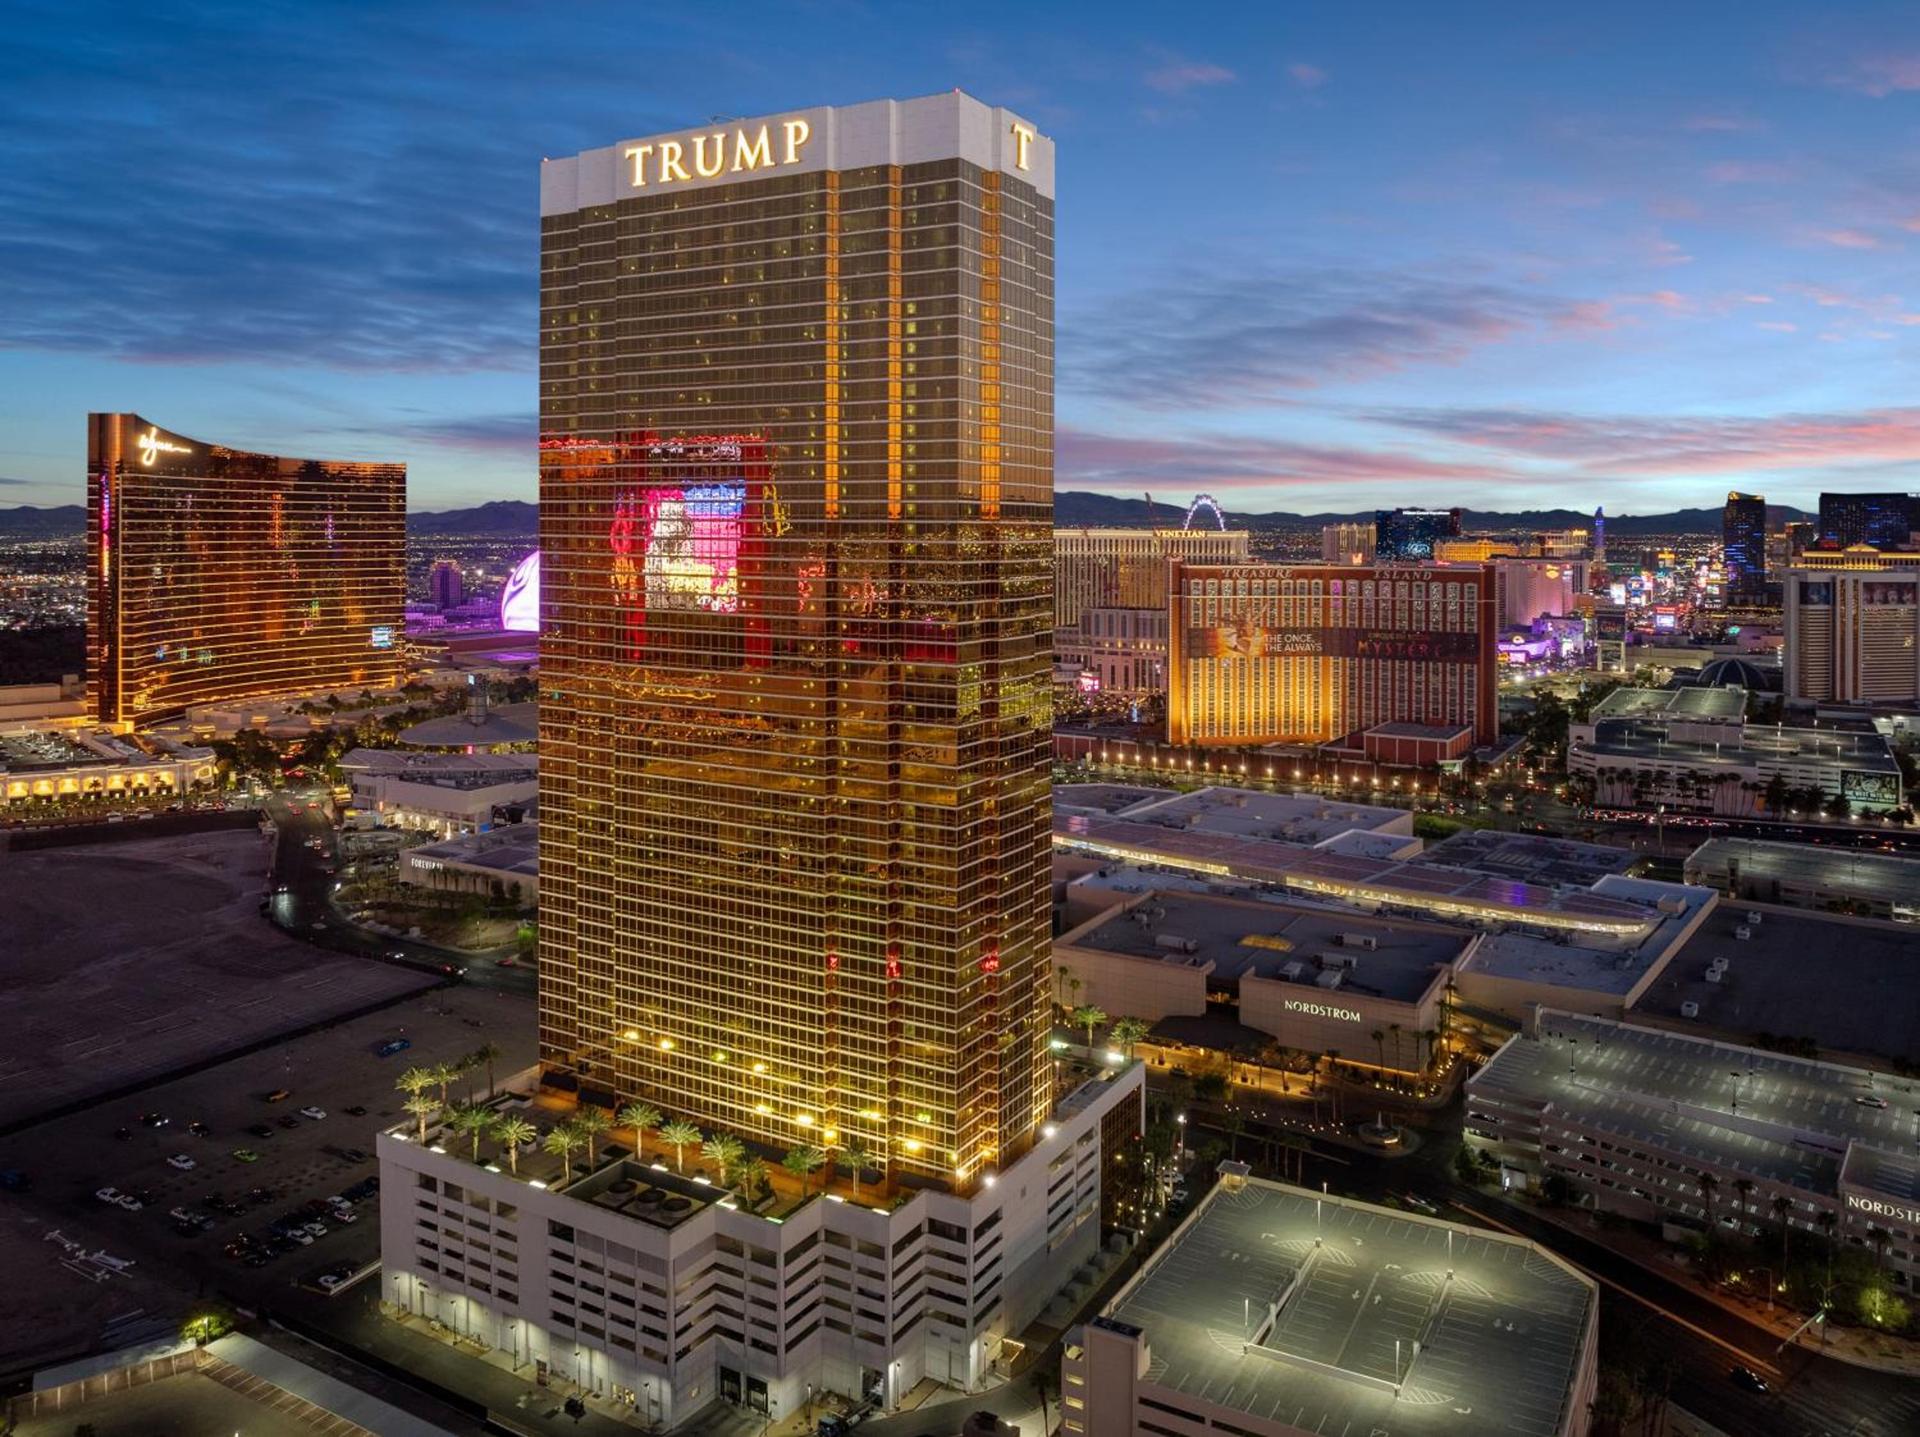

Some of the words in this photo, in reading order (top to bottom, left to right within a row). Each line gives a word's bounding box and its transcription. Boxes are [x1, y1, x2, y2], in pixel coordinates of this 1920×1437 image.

[625, 119, 810, 187] TRUMP
[1011, 123, 1033, 171] T
[1155, 530, 1206, 538] VENETIAN
[1222, 568, 1293, 579] TREASURE
[1375, 569, 1432, 581] ISLAND
[1263, 633, 1282, 643] THE
[1264, 643, 1282, 652] THE
[1284, 643, 1322, 652] ALWAYS
[1284, 1000, 1360, 1022] NORDSTROM
